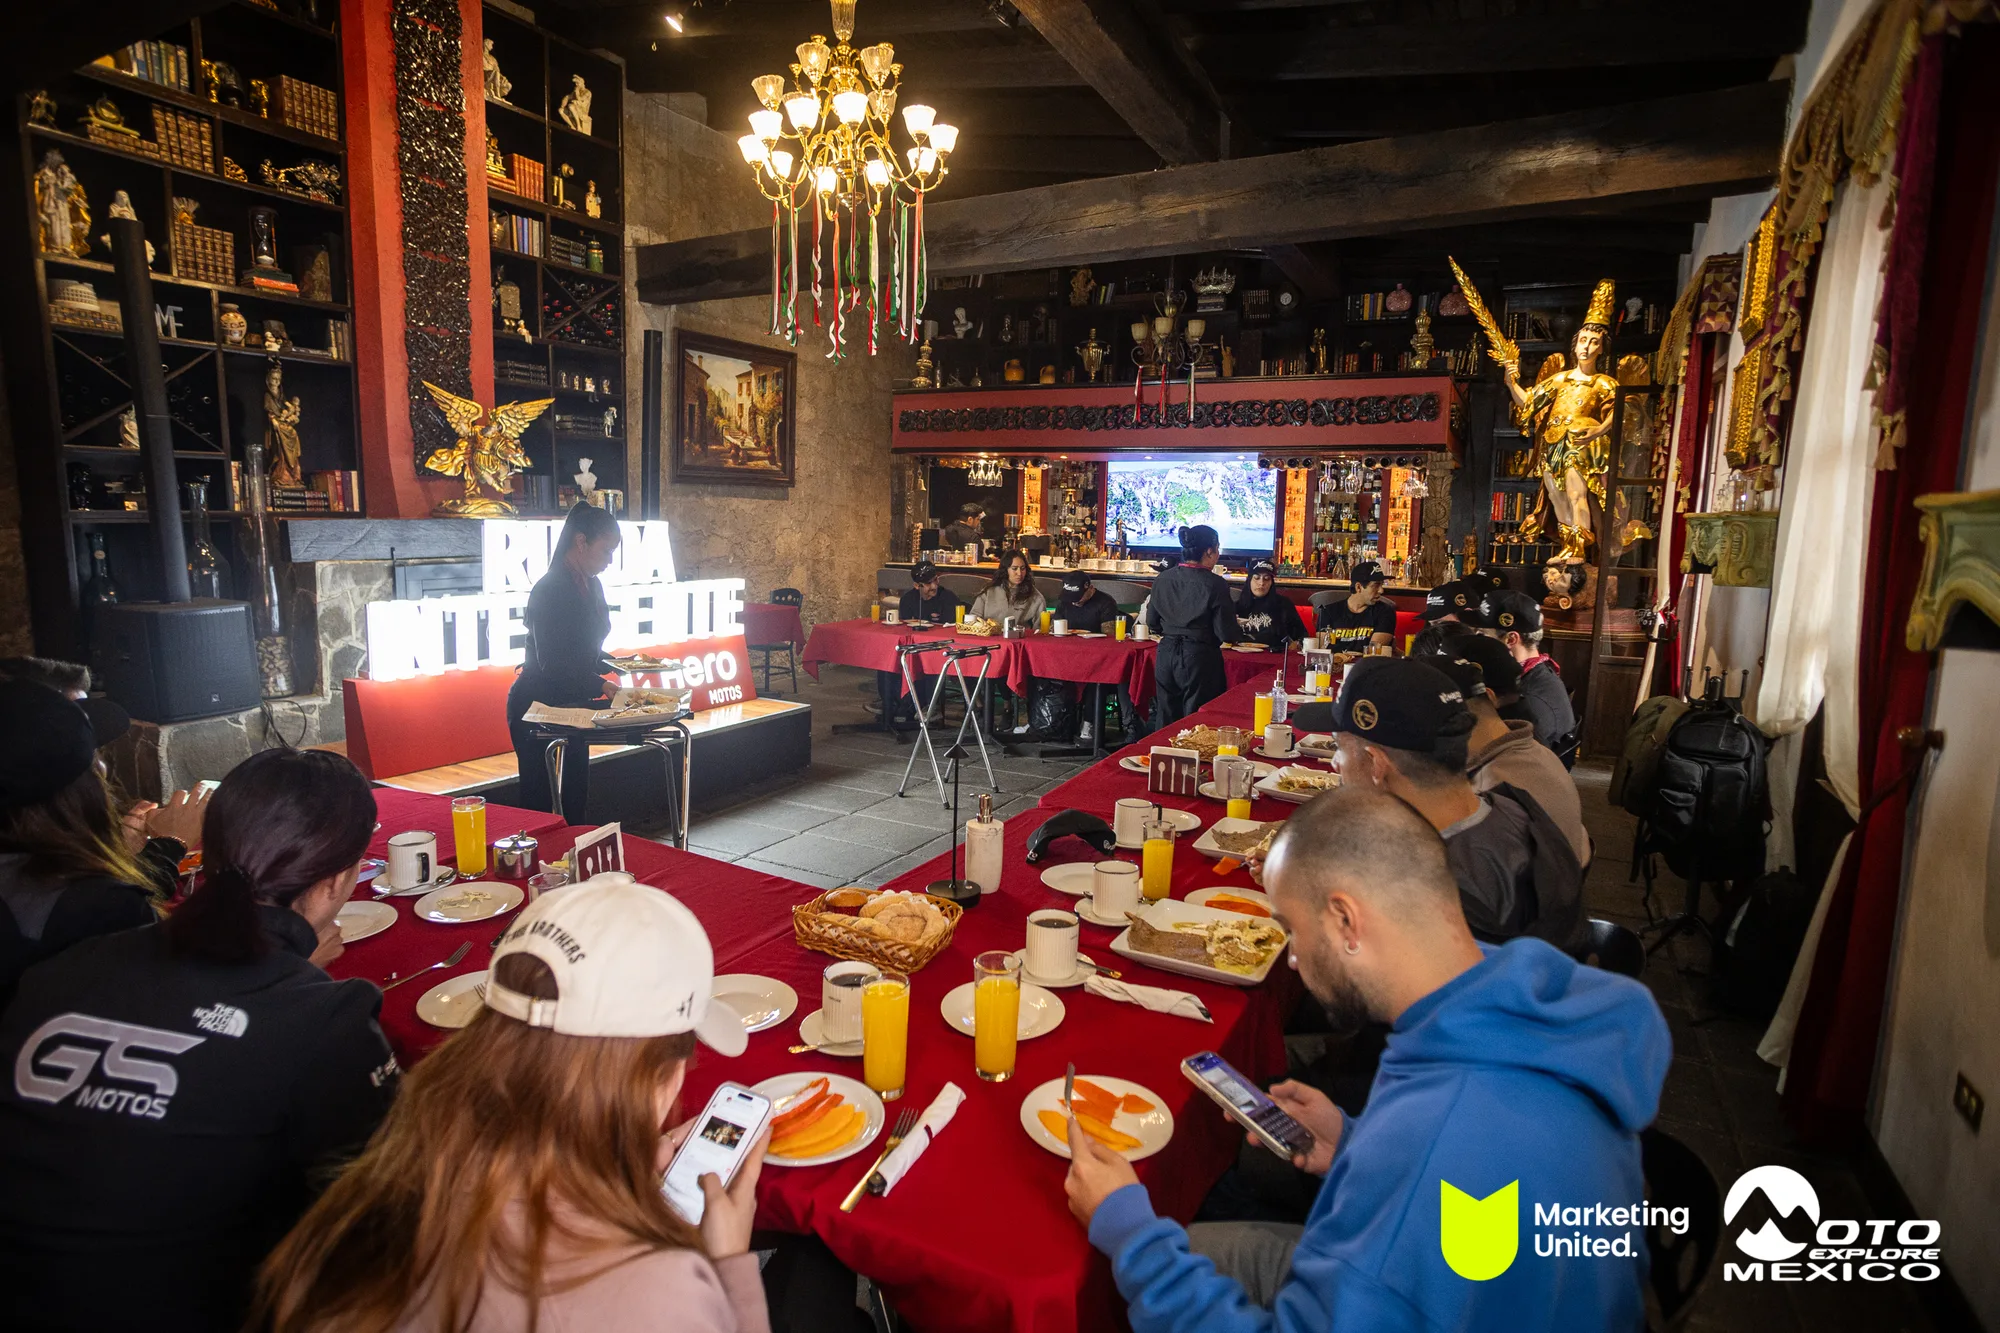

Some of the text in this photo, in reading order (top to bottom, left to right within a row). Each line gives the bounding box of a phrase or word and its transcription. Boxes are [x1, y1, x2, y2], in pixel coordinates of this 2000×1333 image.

[709, 684, 743, 705] MOTOS
[192, 1007, 232, 1025] NORTH
[214, 1003, 236, 1016] THE
[197, 1018, 227, 1033] FACE
[14, 1012, 208, 1105] GS
[75, 1084, 170, 1120] MOTOS
